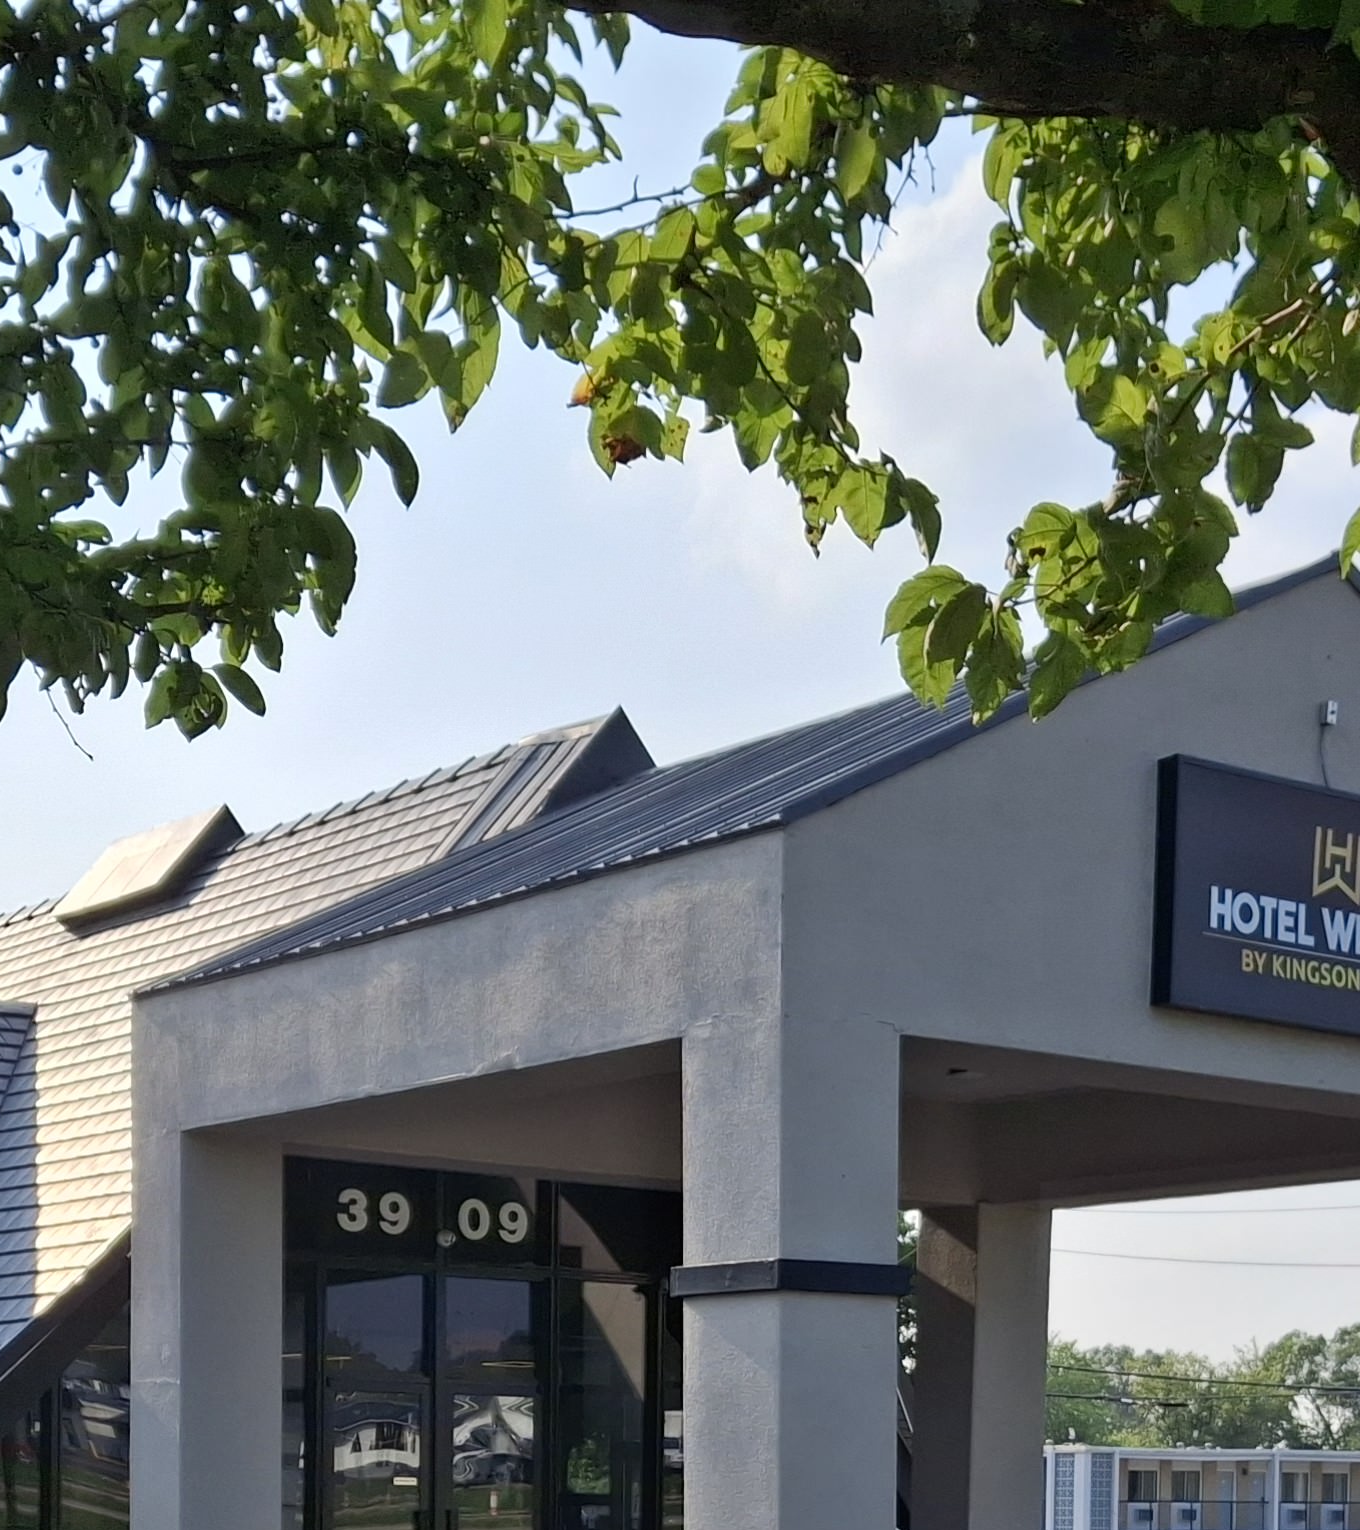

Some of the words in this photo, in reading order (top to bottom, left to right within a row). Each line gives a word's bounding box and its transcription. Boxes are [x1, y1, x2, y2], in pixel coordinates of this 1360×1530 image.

[1209, 885, 1314, 947] HOTEL
[1241, 949, 1267, 975] BY
[1272, 954, 1360, 991] KINGSON
